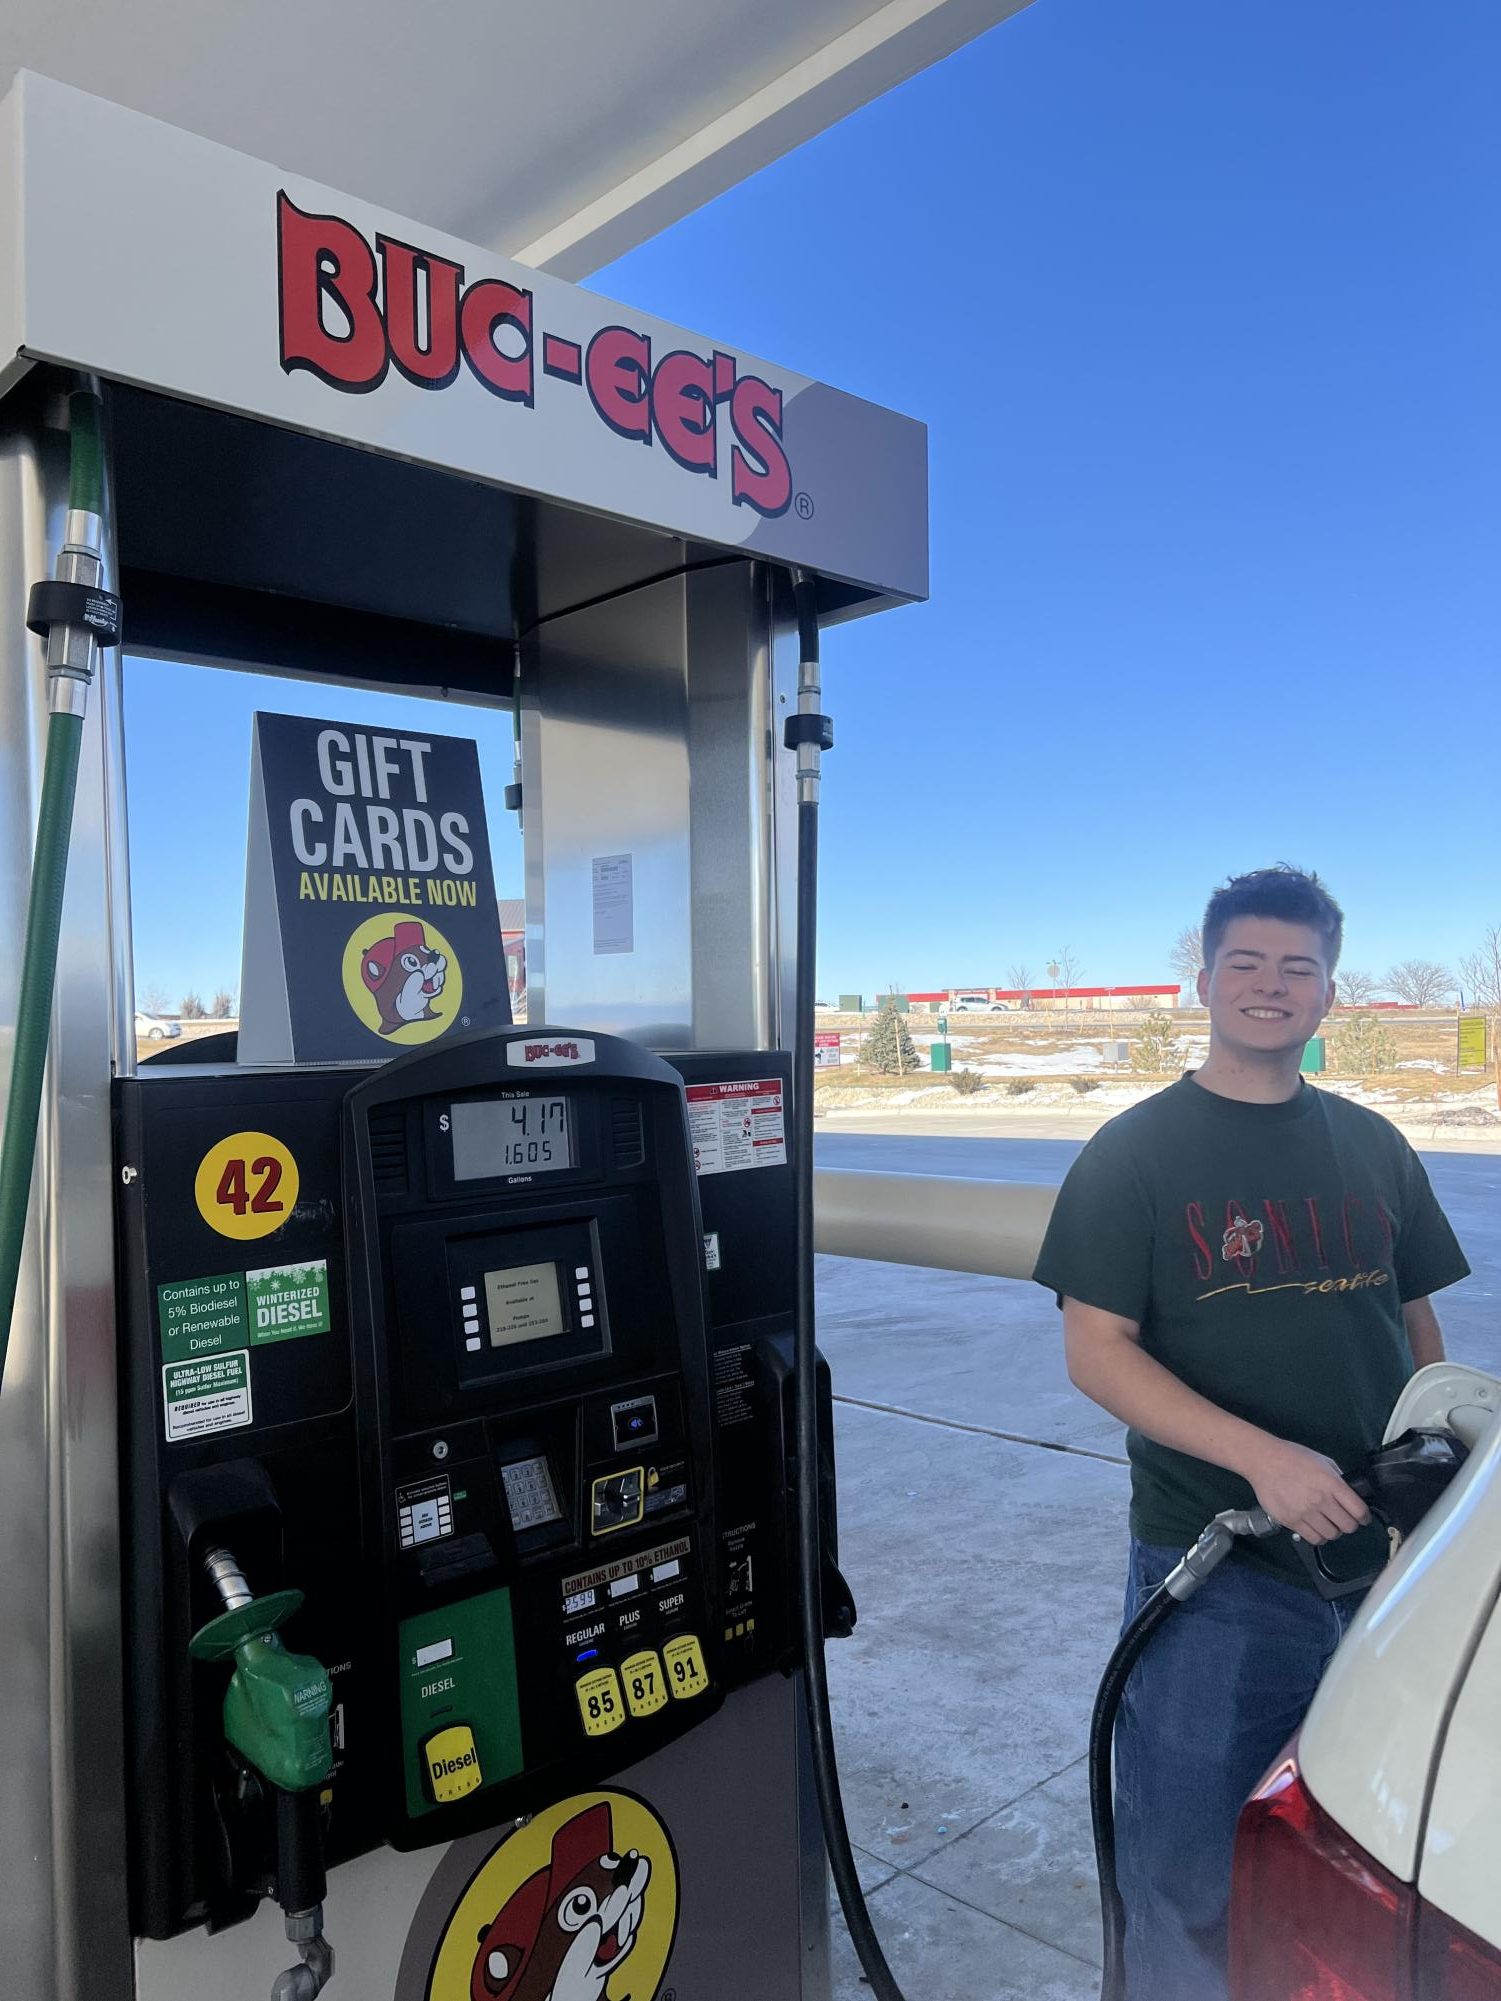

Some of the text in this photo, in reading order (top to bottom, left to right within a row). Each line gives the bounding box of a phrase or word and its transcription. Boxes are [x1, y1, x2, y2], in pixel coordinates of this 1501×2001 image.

[317, 729, 432, 803] GIFT
[290, 798, 474, 875] CARDS
[300, 872, 476, 907] AVAILABLE NOW
[720, 1082, 759, 1093] WARNING
[439, 1114, 449, 1132] $
[512, 1102, 564, 1136] 4.17
[505, 1140, 551, 1165] 1.605
[216, 1156, 283, 1215] 42
[508, 1175, 532, 1184] Gallons
[163, 1280, 240, 1301] Contains up to
[256, 1286, 320, 1306] WINTERIZED
[168, 1296, 238, 1318] 5% Biodiesel
[257, 1299, 322, 1328] DIESEL
[168, 1316, 240, 1336] or Renewable
[190, 1334, 222, 1350] Diesel
[170, 1367, 242, 1388] HIGHWAY DIESEL FUEL
[173, 1360, 238, 1379] ULTRA-LOW SULFUR
[174, 1402, 201, 1412] REQUIRED
[564, 1542, 689, 1594] CONTAINS UP TO 10% ETHANOL
[658, 1594, 684, 1612] SUPER
[619, 1610, 640, 1627] PLUS
[566, 1623, 605, 1646] REGULAR
[674, 1657, 698, 1682] 91
[421, 1678, 456, 1698] DIESEL
[632, 1672, 654, 1700] 87
[588, 1690, 614, 1719] 85
[432, 1748, 476, 1780] Diesel
[439, 1778, 480, 1799] PRESS
